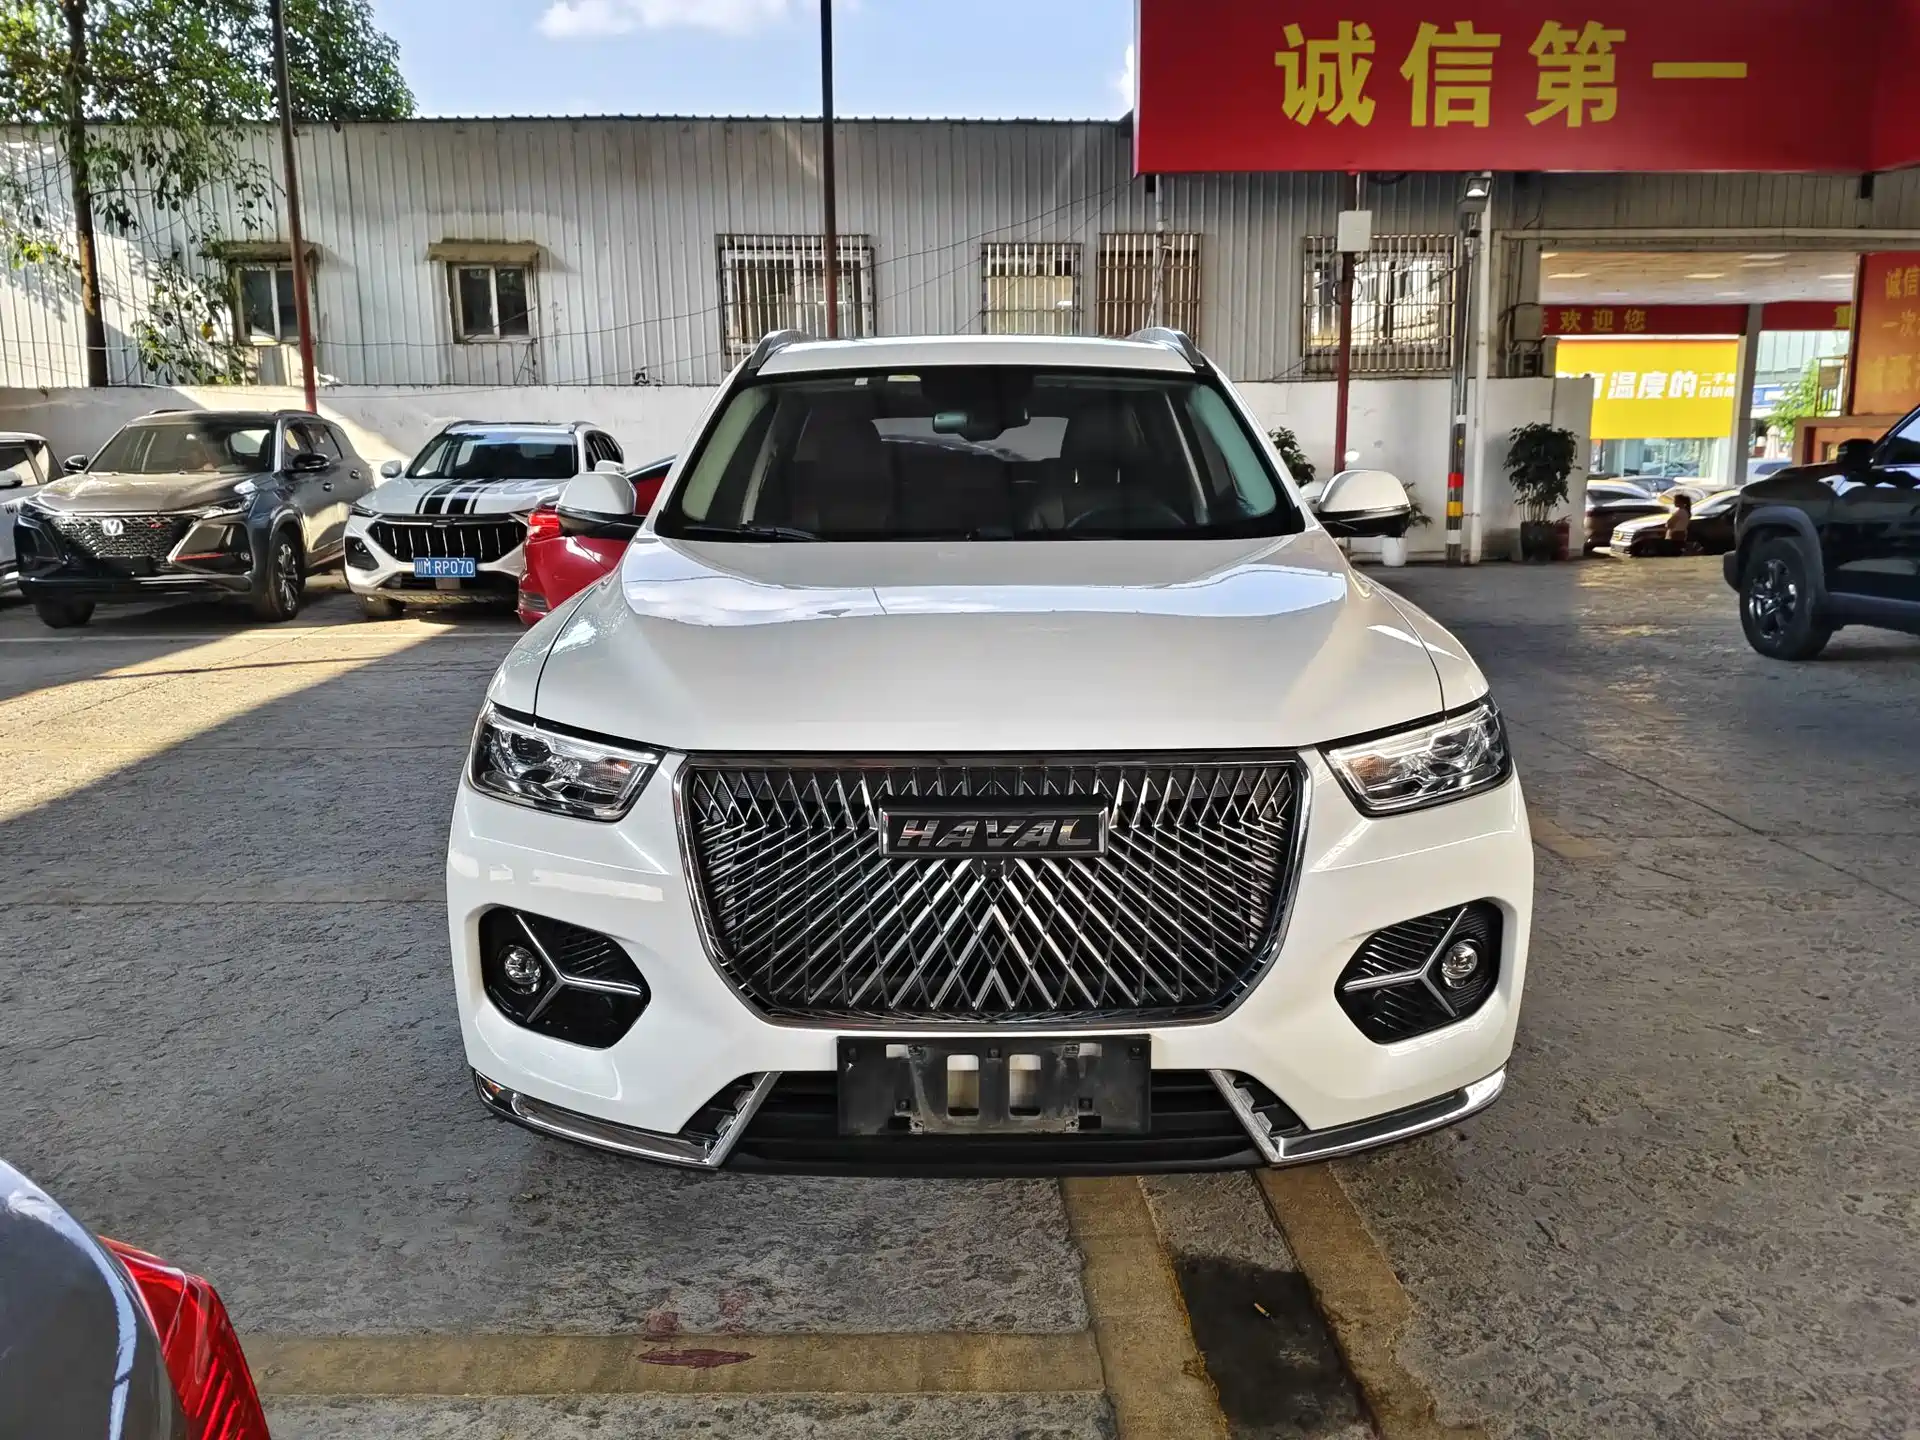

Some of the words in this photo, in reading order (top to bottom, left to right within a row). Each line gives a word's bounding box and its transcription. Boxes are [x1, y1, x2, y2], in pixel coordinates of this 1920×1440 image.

[1275, 20, 1748, 128] 诚信第一
[1543, 308, 1647, 332] 欢迎您
[1882, 308, 1920, 336] 一次
[897, 819, 1093, 849] HAVAL
